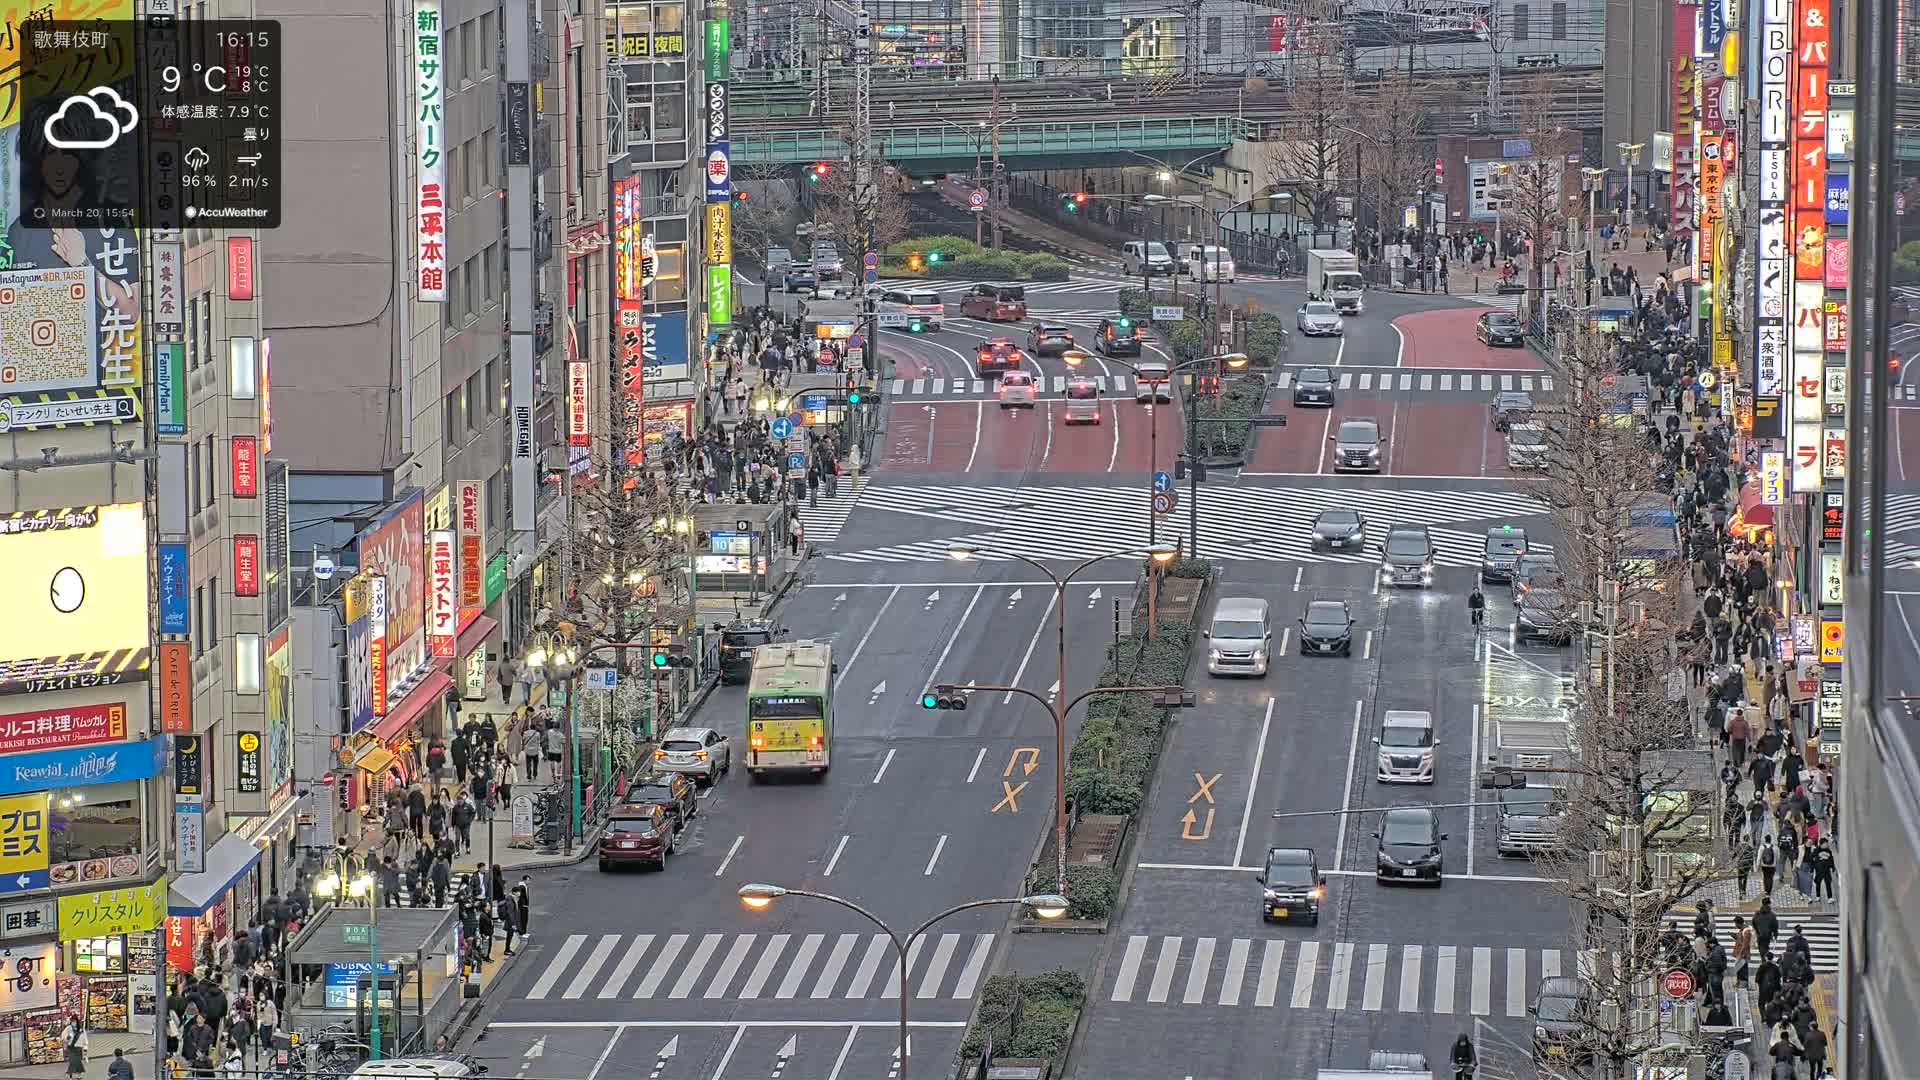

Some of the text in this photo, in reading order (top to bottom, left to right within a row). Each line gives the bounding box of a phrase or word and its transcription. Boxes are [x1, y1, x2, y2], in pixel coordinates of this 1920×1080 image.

[622, 36, 648, 55] 祝日
[655, 35, 683, 53] 夜間
[418, 10, 442, 169] 新宿サンパーク
[710, 83, 725, 138] もつなべ
[1708, 88, 1718, 119] アコム
[710, 160, 727, 178] 薬
[421, 183, 443, 291] 三平本館
[713, 206, 727, 262] 肉汁水餃子
[712, 274, 727, 313] レイク
[1827, 304, 1836, 313] 6F
[160, 323, 178, 333] 3F
[624, 329, 640, 387] ラーメン
[1761, 330, 1775, 382] 大衆酒場
[159, 353, 171, 414] FamilyMart
[1797, 306, 1822, 468] パセラ
[16, 403, 113, 420] テンクリ たいせい先生
[1830, 405, 1843, 414] 5F
[463, 487, 474, 529] GAME
[1829, 497, 1842, 505] 3F
[435, 541, 451, 628] 三平ストア
[1828, 576, 1841, 601] ねぎし
[28, 735, 71, 746] RESTAURANT
[2, 809, 41, 834] プロ
[3, 837, 42, 858] ミス
[7, 910, 41, 930] 囲碁
[72, 902, 144, 927] クリスタル
[330, 989, 345, 1003] 12
